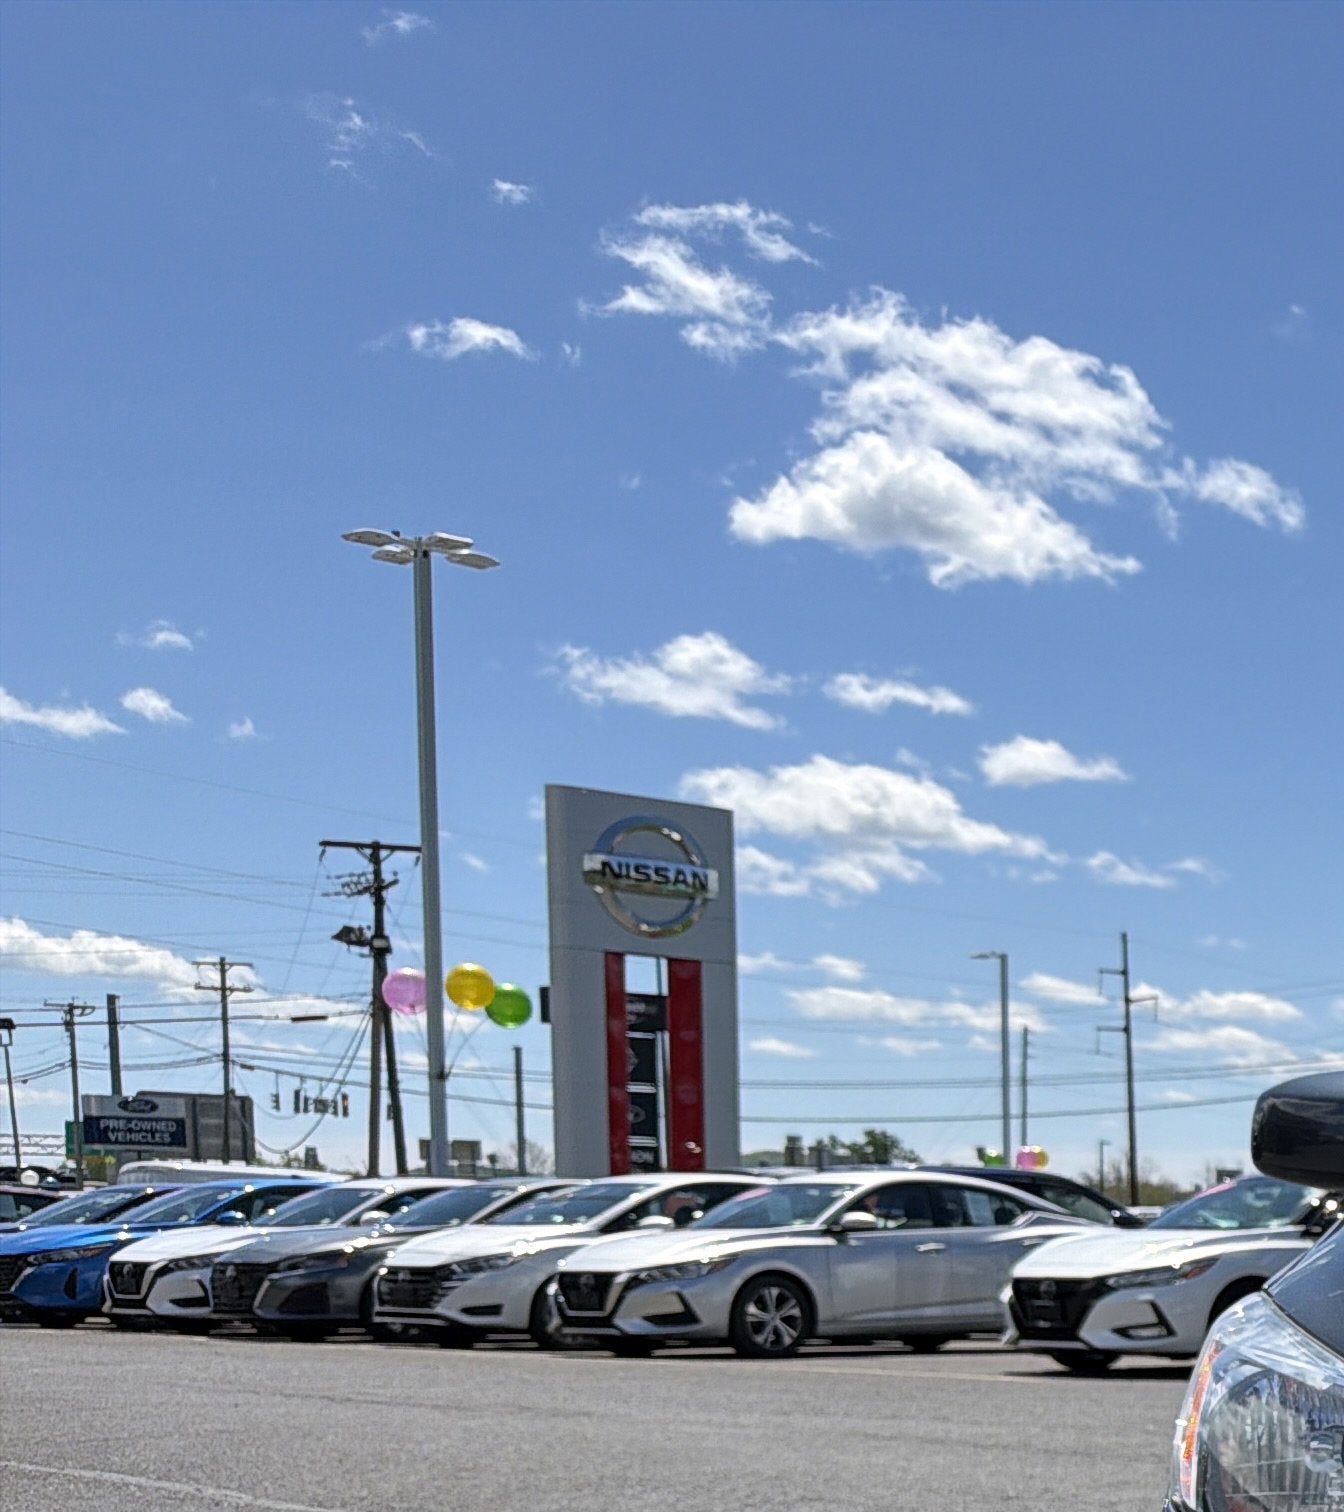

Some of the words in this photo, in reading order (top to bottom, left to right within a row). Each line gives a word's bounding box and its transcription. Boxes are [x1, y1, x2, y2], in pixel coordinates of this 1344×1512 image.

[601, 860, 708, 891] NISSAN
[101, 1119, 177, 1132] PRE-OWNED
[108, 1132, 171, 1143] VEHICLES
